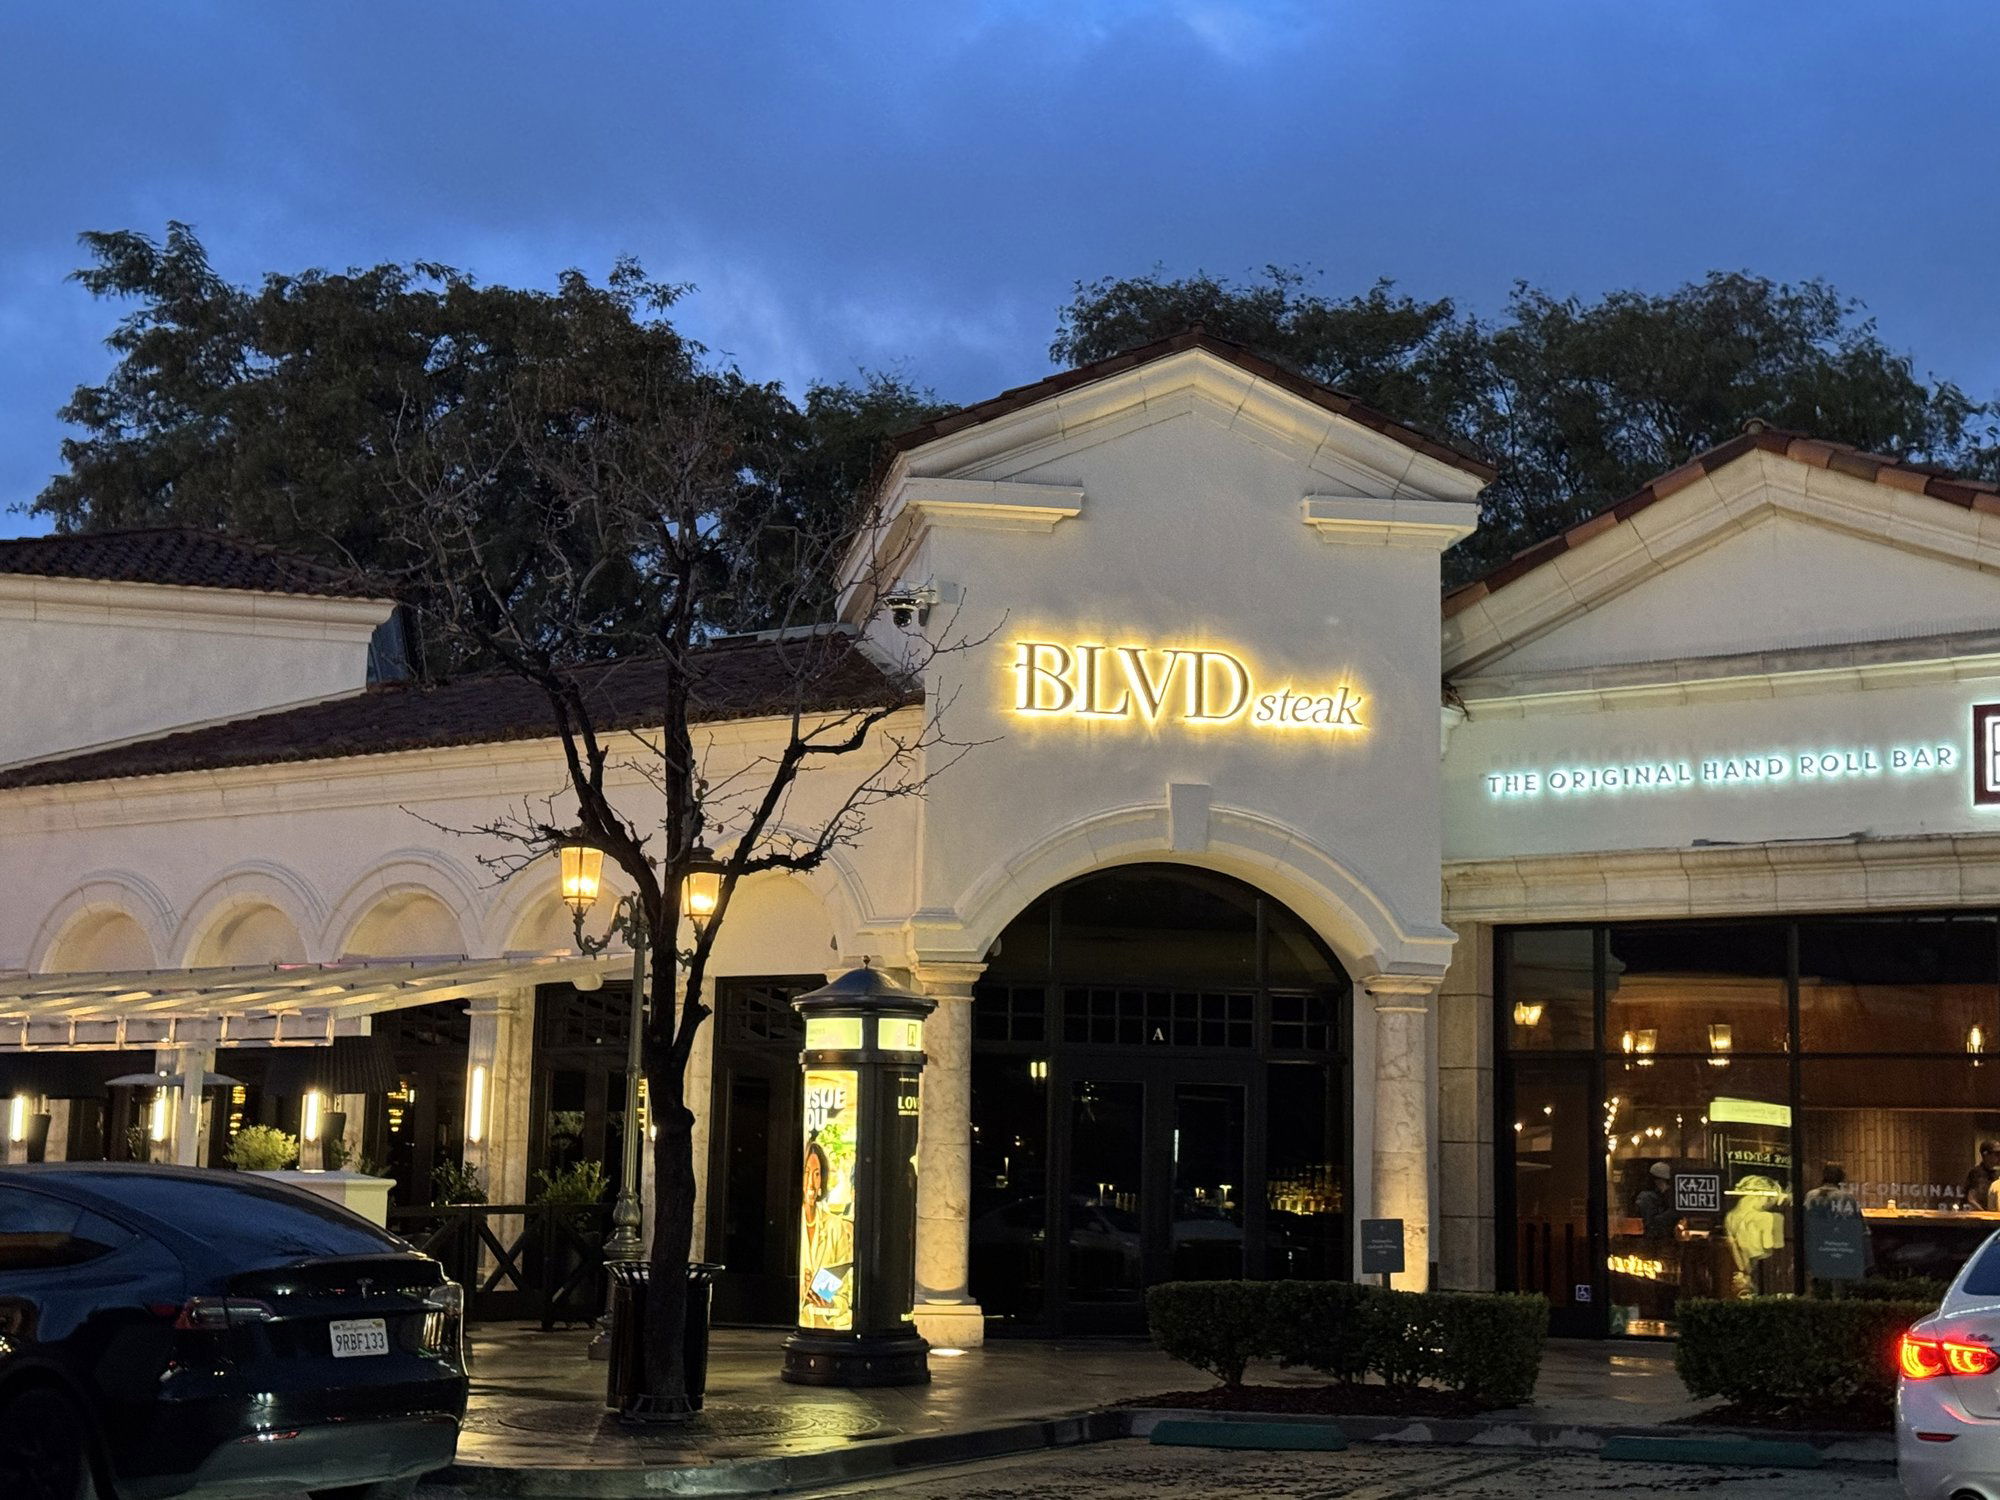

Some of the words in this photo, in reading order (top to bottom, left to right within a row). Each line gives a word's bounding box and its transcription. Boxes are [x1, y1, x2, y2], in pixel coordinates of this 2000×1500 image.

[1015, 642, 1250, 718] BLVD
[1256, 687, 1364, 726] steak
[1488, 774, 1537, 794] THE
[1549, 764, 1691, 790] ORIGINAL
[1703, 757, 1785, 781] HAND
[1800, 751, 1878, 774] ROLL
[1893, 747, 1954, 769] BAR
[1152, 1027, 1165, 1041] A
[1679, 1178, 1716, 1192] KAZU
[1838, 1182, 1870, 1198] THE
[1876, 1182, 1965, 1198] ORIGINAL
[1679, 1193, 1716, 1207] NORI
[336, 1332, 385, 1351] 9RBF133
